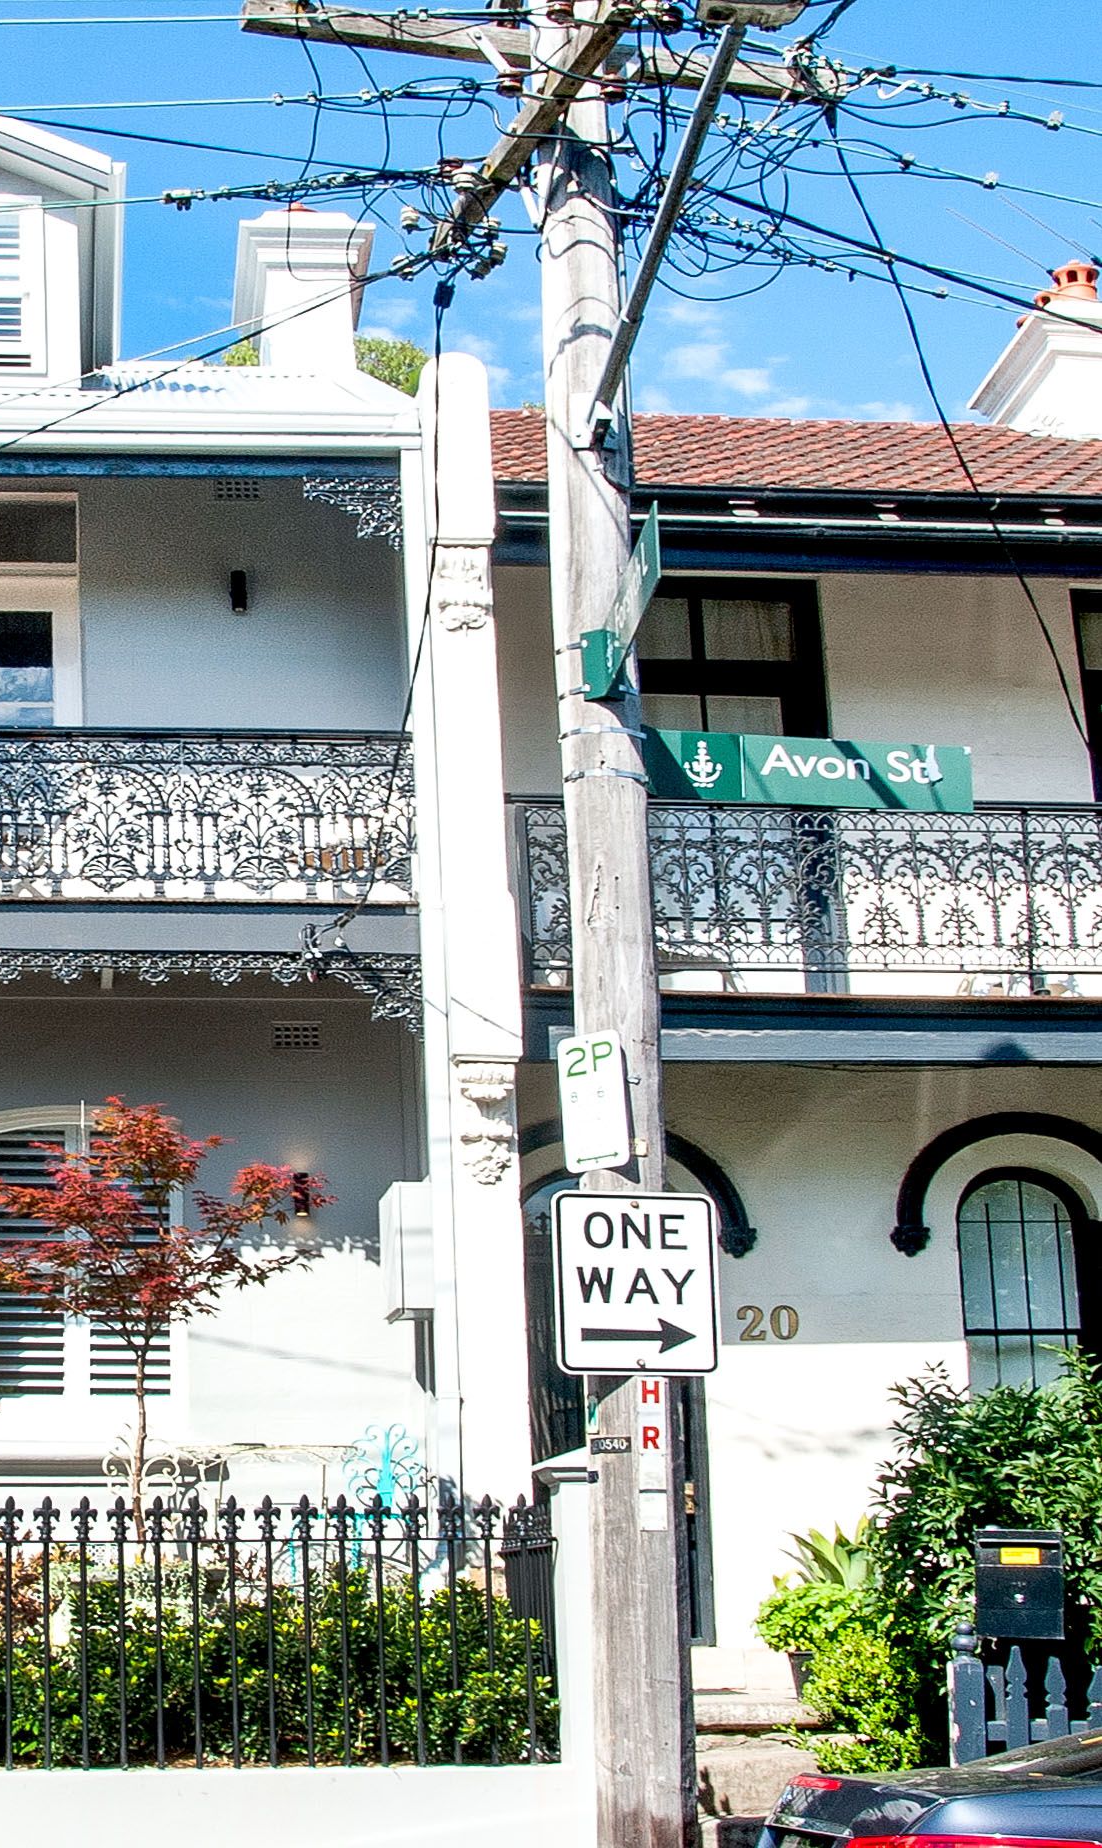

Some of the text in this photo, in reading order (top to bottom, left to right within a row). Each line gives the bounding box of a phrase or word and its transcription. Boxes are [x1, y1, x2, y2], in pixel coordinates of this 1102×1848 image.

[760, 744, 930, 784] Avon St
[565, 1041, 612, 1077] 2P
[583, 1211, 688, 1250] ONE
[576, 1266, 695, 1304] WAY
[736, 1305, 799, 1341] 20
[641, 1380, 660, 1404] H
[642, 1426, 660, 1450] R
